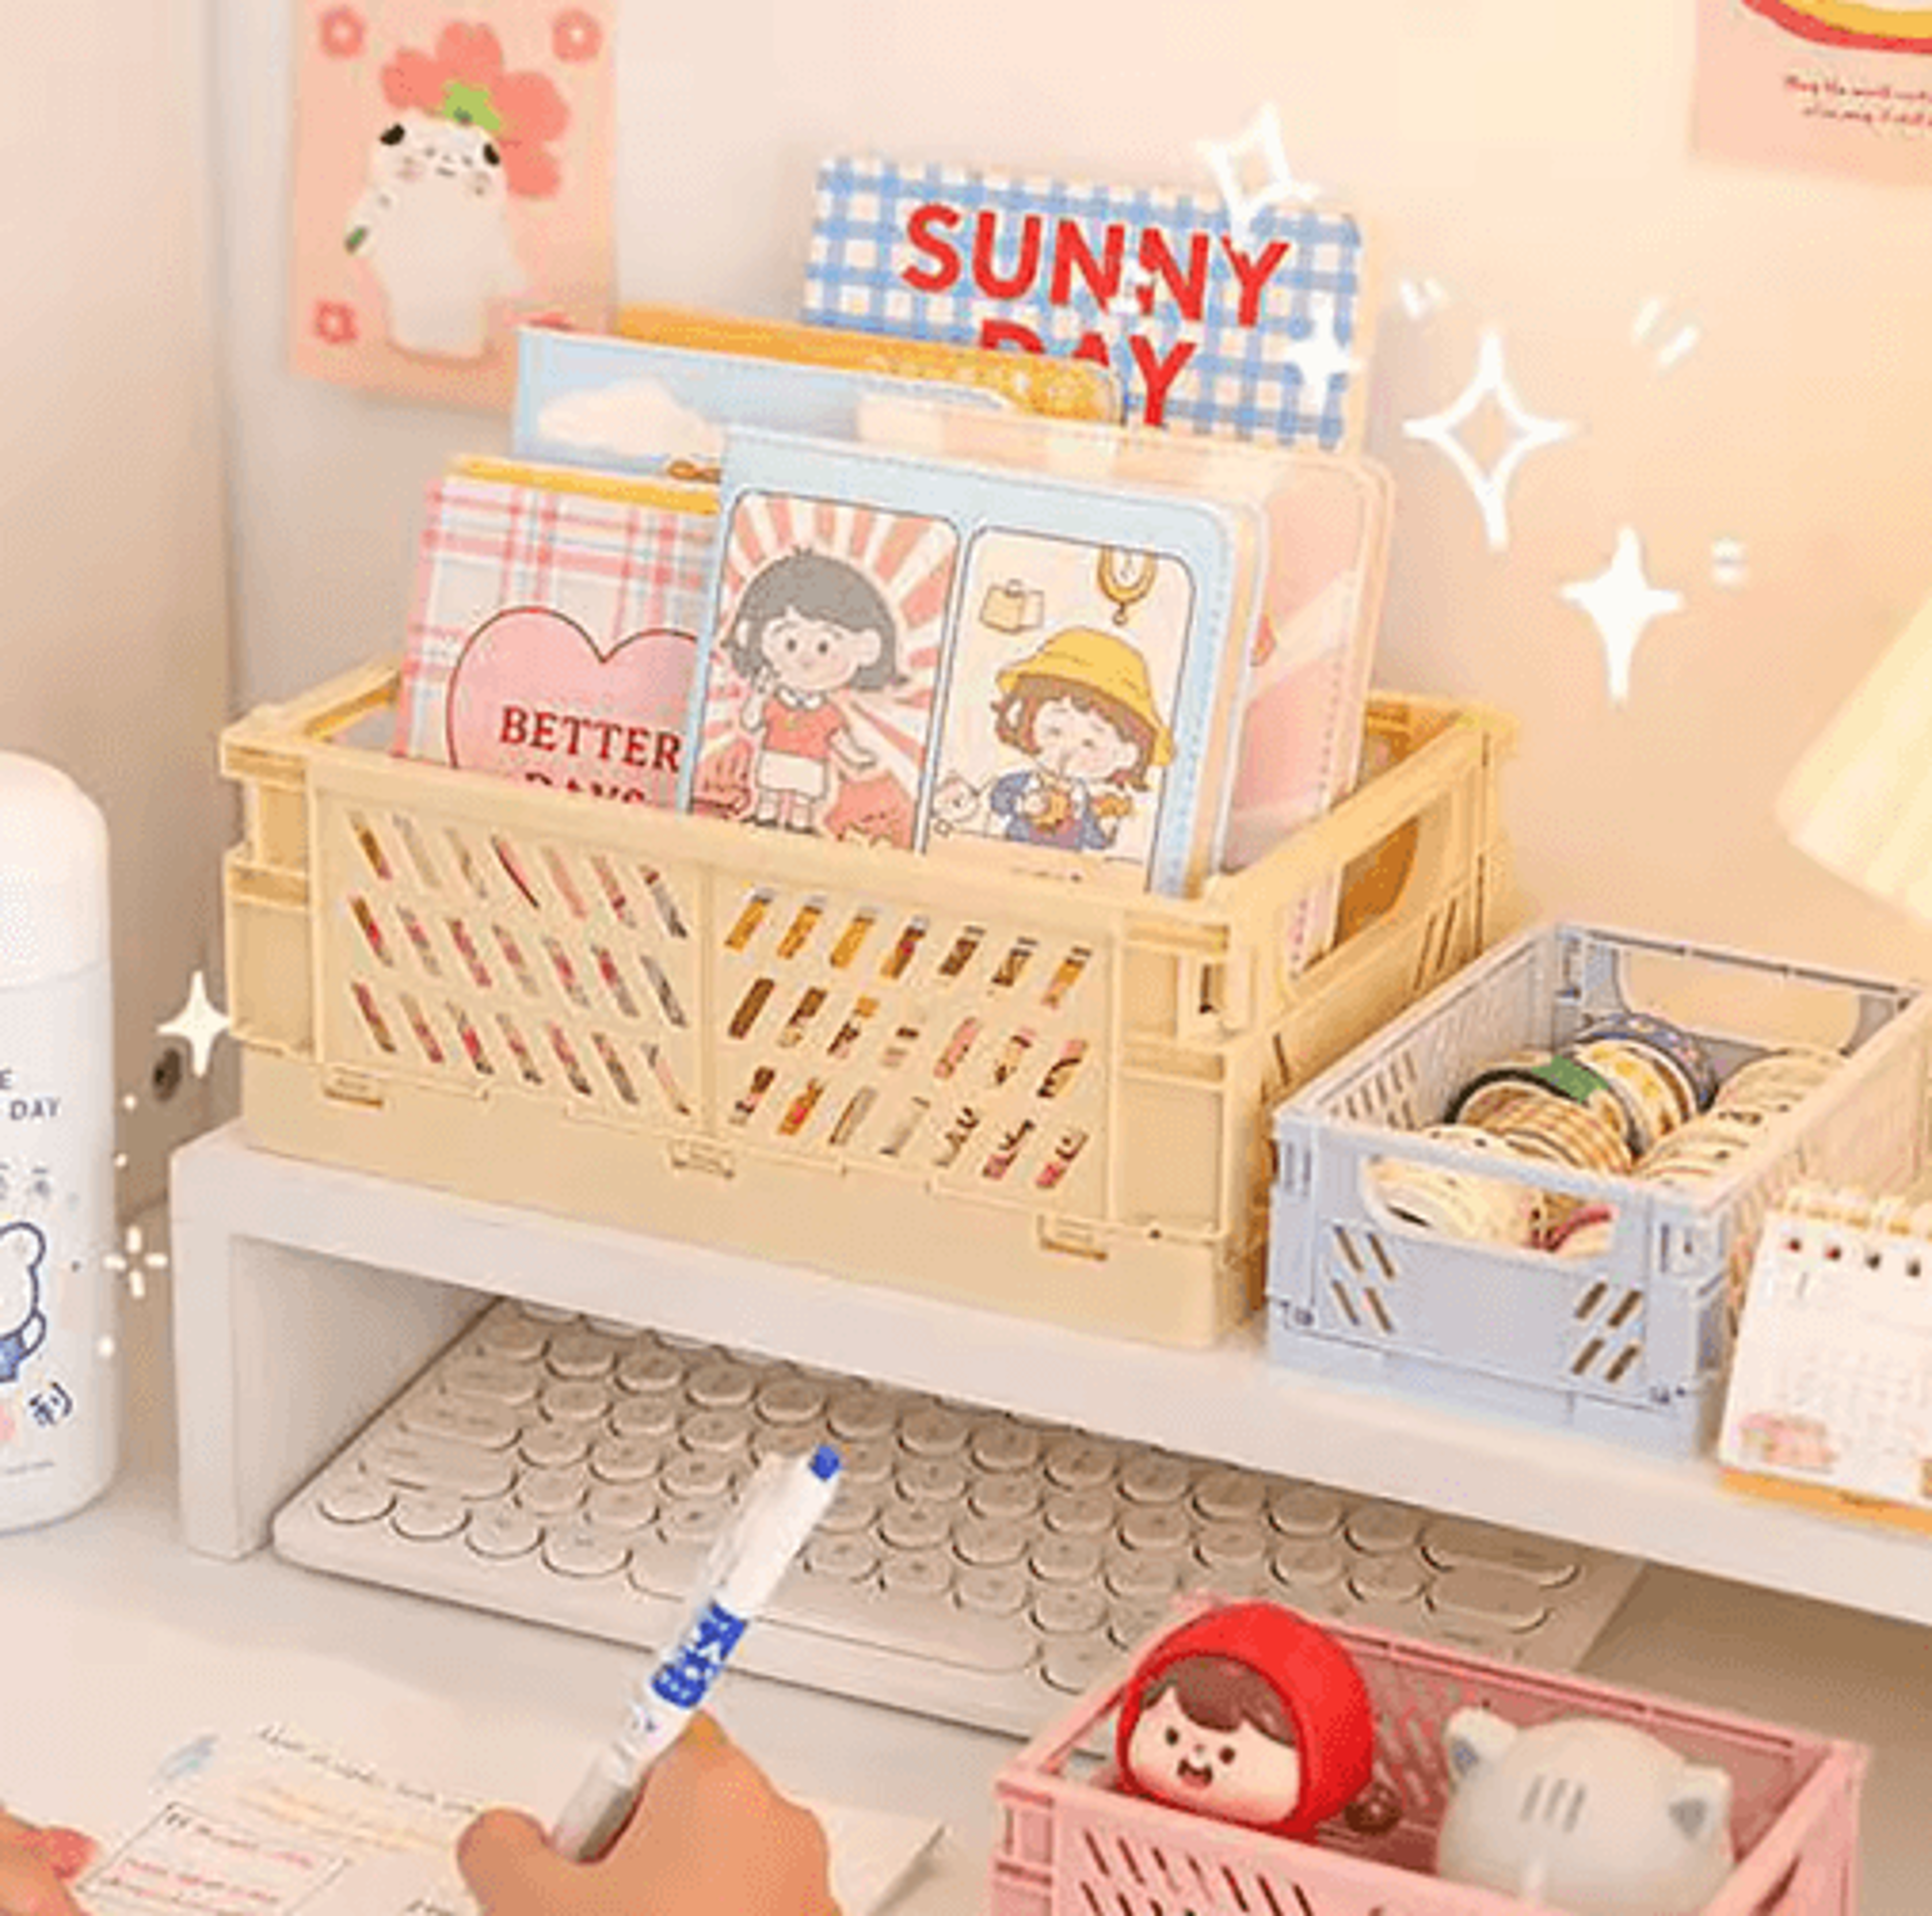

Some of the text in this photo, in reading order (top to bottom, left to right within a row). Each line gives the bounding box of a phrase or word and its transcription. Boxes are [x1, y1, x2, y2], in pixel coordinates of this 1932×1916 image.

[902, 203, 1290, 327] SUNNY
[500, 706, 682, 773] BETTER
[10, 1096, 62, 1121] DAY
